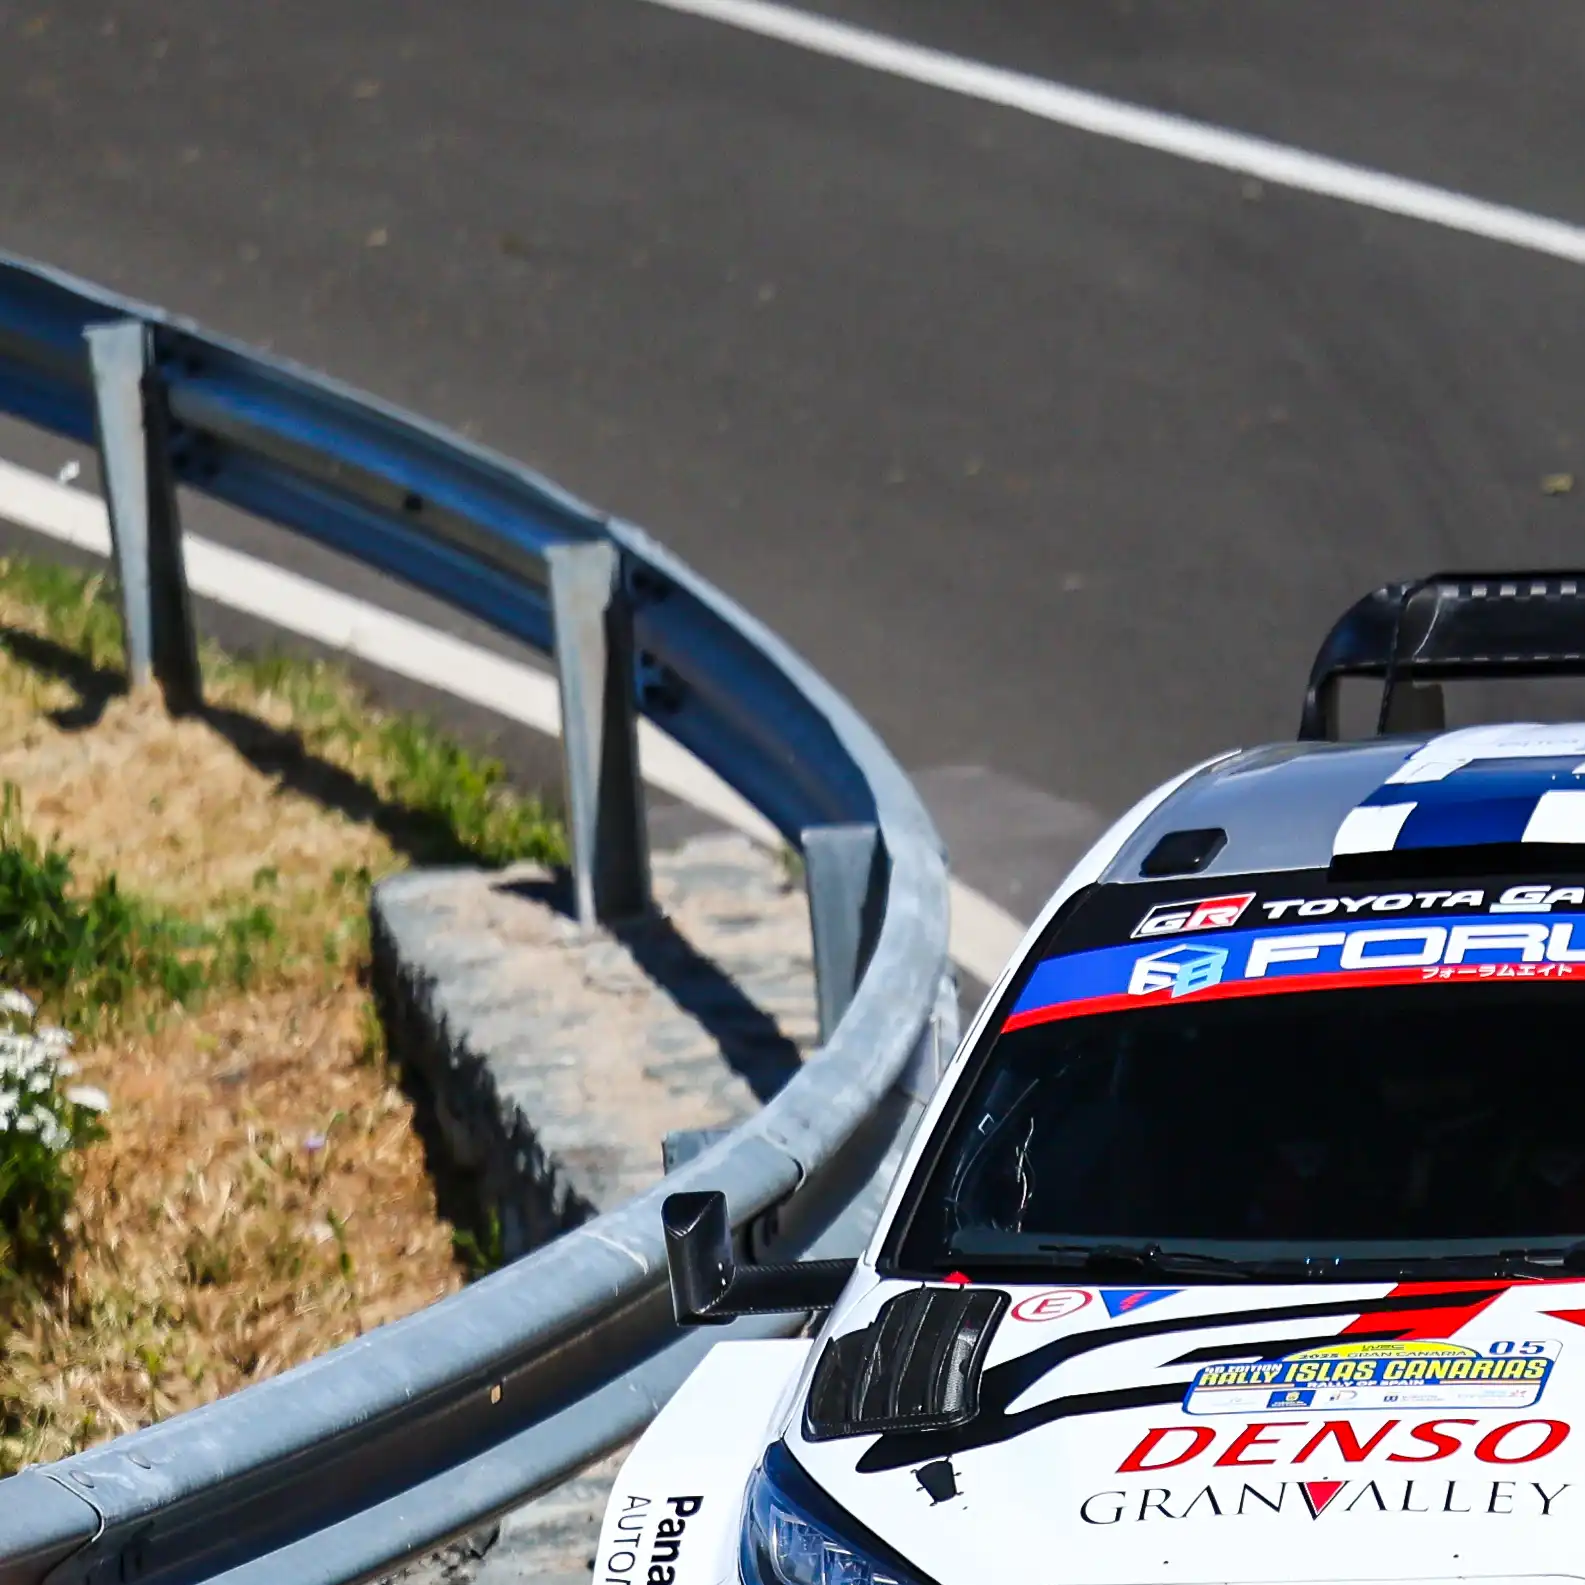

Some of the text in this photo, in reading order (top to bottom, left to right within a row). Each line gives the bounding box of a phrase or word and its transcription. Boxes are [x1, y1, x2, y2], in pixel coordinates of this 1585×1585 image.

[1137, 898, 1245, 935] GR
[1262, 890, 1484, 920] TOYOTA
[1421, 963, 1574, 980] フォーラムエイト
[1488, 1339, 1546, 1356] 05
[1200, 1358, 1546, 1386] RALLY ISLAS CANARIAS
[1306, 1381, 1354, 1389] RALLY
[1380, 1379, 1425, 1387] SPAIN
[1115, 1418, 1572, 1474] DENSO
[1079, 1479, 1574, 1526] GRANVALLEY
